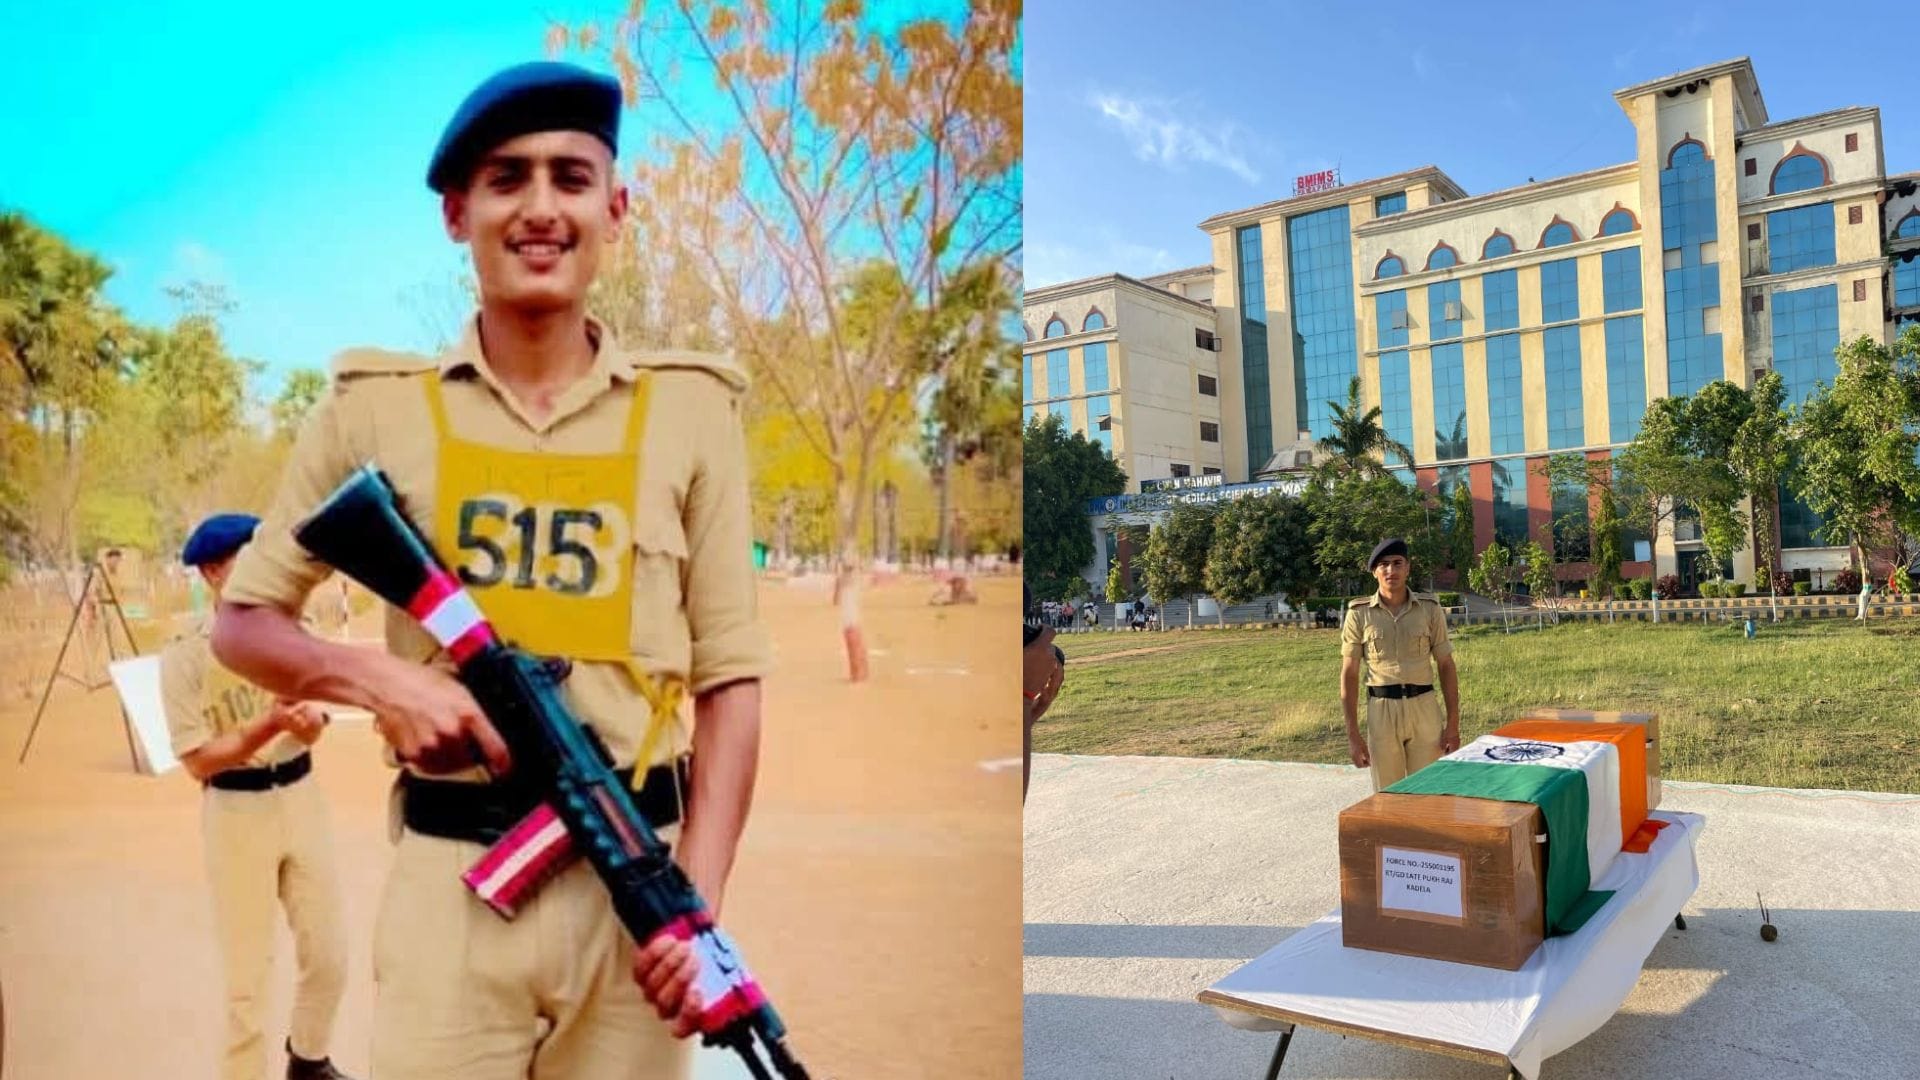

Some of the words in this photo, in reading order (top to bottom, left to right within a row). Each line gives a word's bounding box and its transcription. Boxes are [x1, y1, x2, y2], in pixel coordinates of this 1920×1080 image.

[1297, 170, 1334, 188] BMIMS
[1184, 475, 1222, 488] MAHAVIR
[457, 499, 603, 596] 515
[1386, 857, 1406, 866] FORCE
[1406, 872, 1421, 881] LATE
[1441, 877, 1453, 885] RAJ
